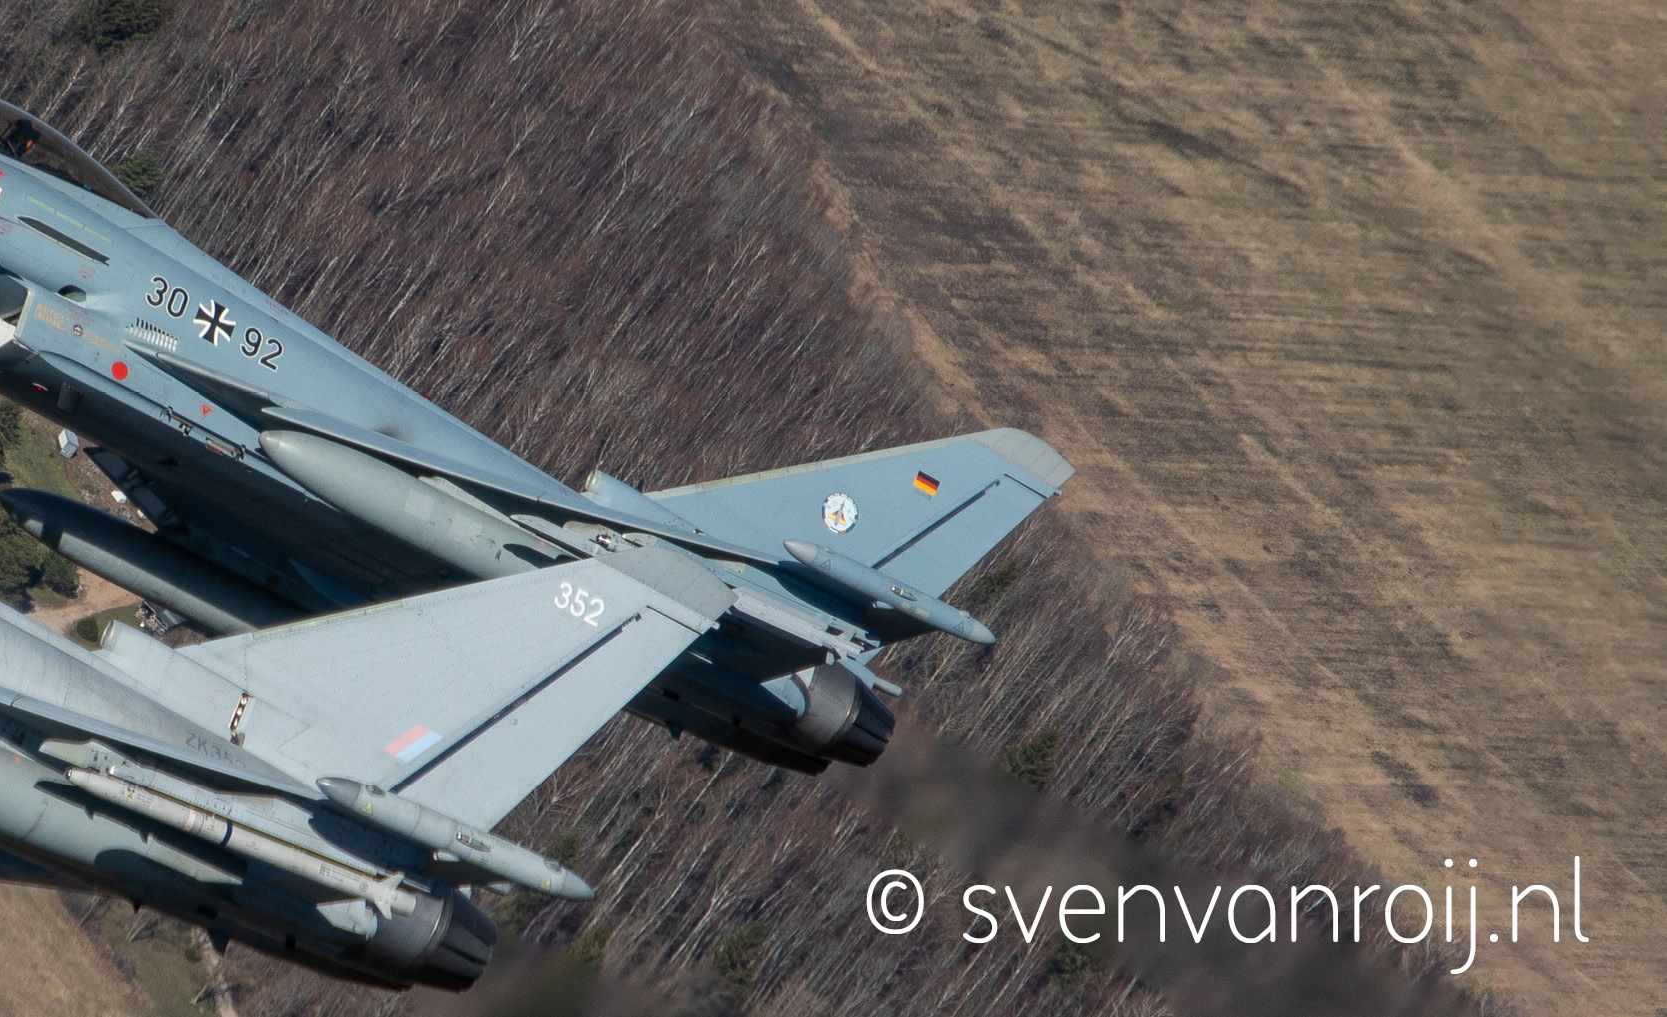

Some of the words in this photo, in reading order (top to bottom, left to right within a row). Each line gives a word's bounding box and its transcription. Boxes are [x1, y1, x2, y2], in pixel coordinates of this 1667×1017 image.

[145, 276, 189, 318] 30
[240, 326, 284, 373] 92
[554, 582, 605, 627] 352
